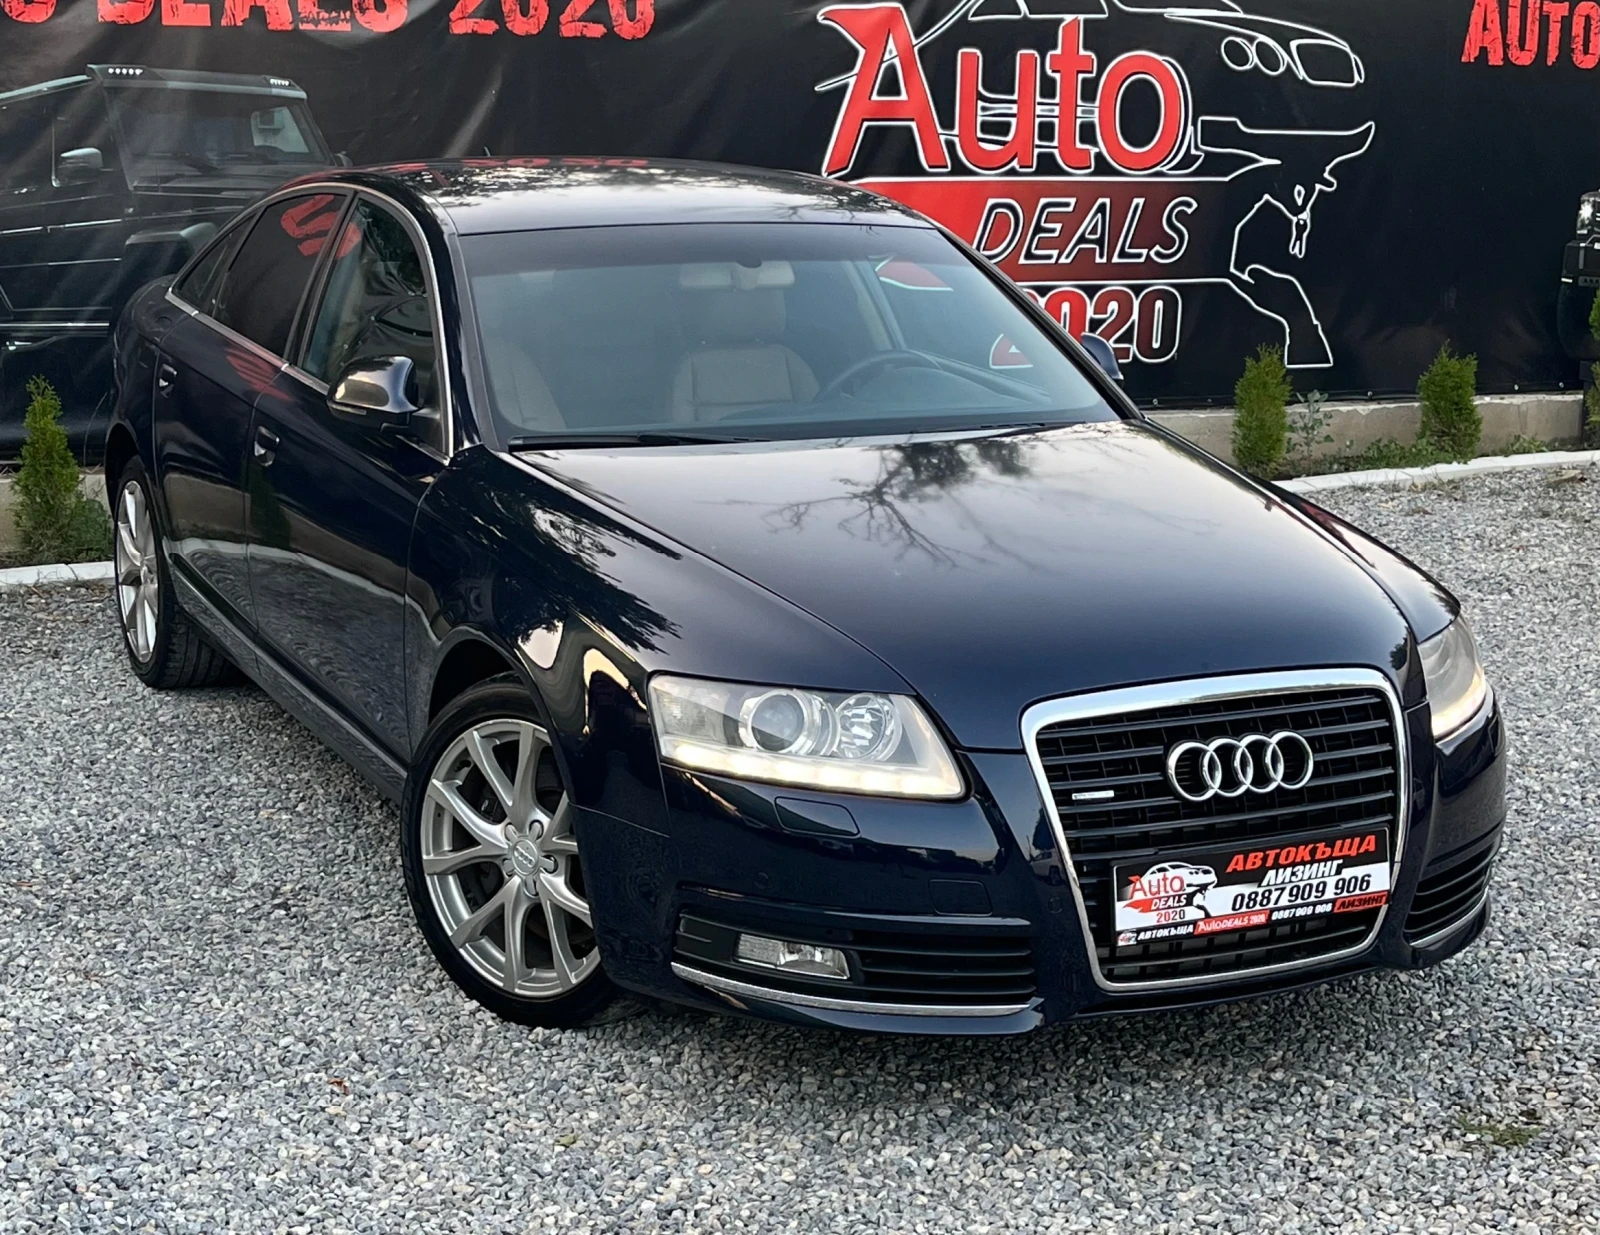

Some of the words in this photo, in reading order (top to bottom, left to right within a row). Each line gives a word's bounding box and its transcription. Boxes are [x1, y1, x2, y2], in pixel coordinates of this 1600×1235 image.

[1461, 0, 1600, 69] AUTO
[817, 3, 1183, 177] Auto
[973, 197, 1198, 264] DEALS
[1225, 835, 1376, 873] АВТОКЪЩА
[1128, 873, 1185, 900] Auto
[1260, 859, 1343, 887] ЛИЗИНГ
[1333, 874, 1372, 896] 906
[1151, 895, 1187, 910] DEALS
[1156, 909, 1186, 924] 2020
[1138, 924, 1194, 941] АВТОКЪЩА
